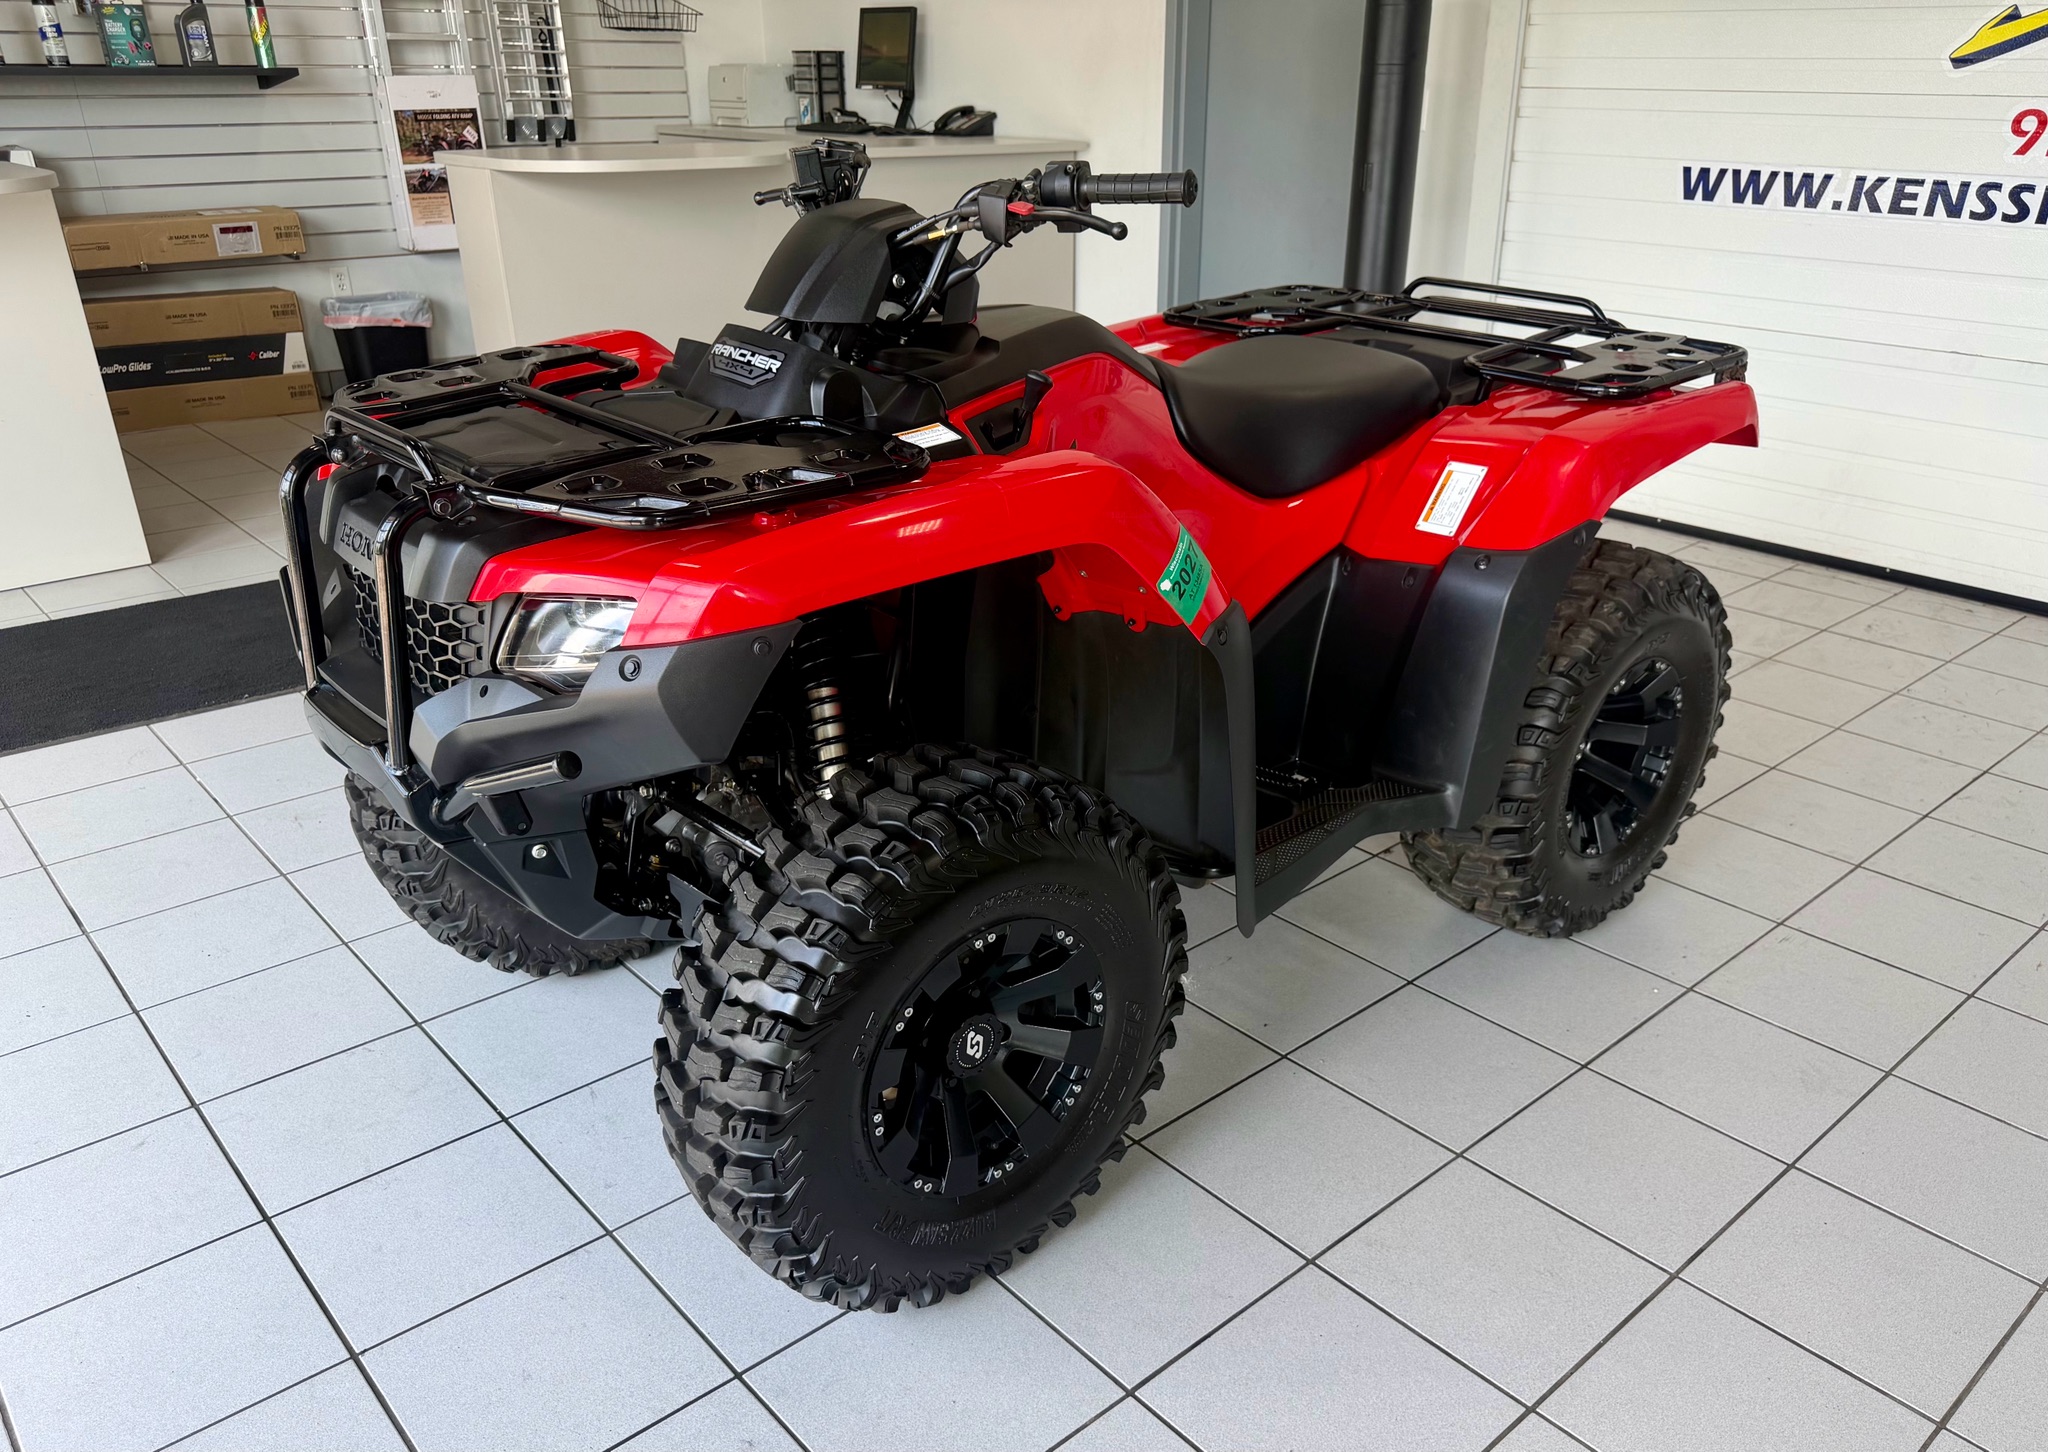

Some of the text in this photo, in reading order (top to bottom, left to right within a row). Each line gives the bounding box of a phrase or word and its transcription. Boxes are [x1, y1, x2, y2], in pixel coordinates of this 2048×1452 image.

[2011, 108, 2048, 157] 9
[128, 362, 152, 372] Glides
[258, 350, 280, 359] Caliber
[711, 344, 782, 373] RANCHER
[340, 521, 374, 561] HON
[1169, 542, 1184, 572] Wisconsin
[1172, 539, 1199, 601] 2027
